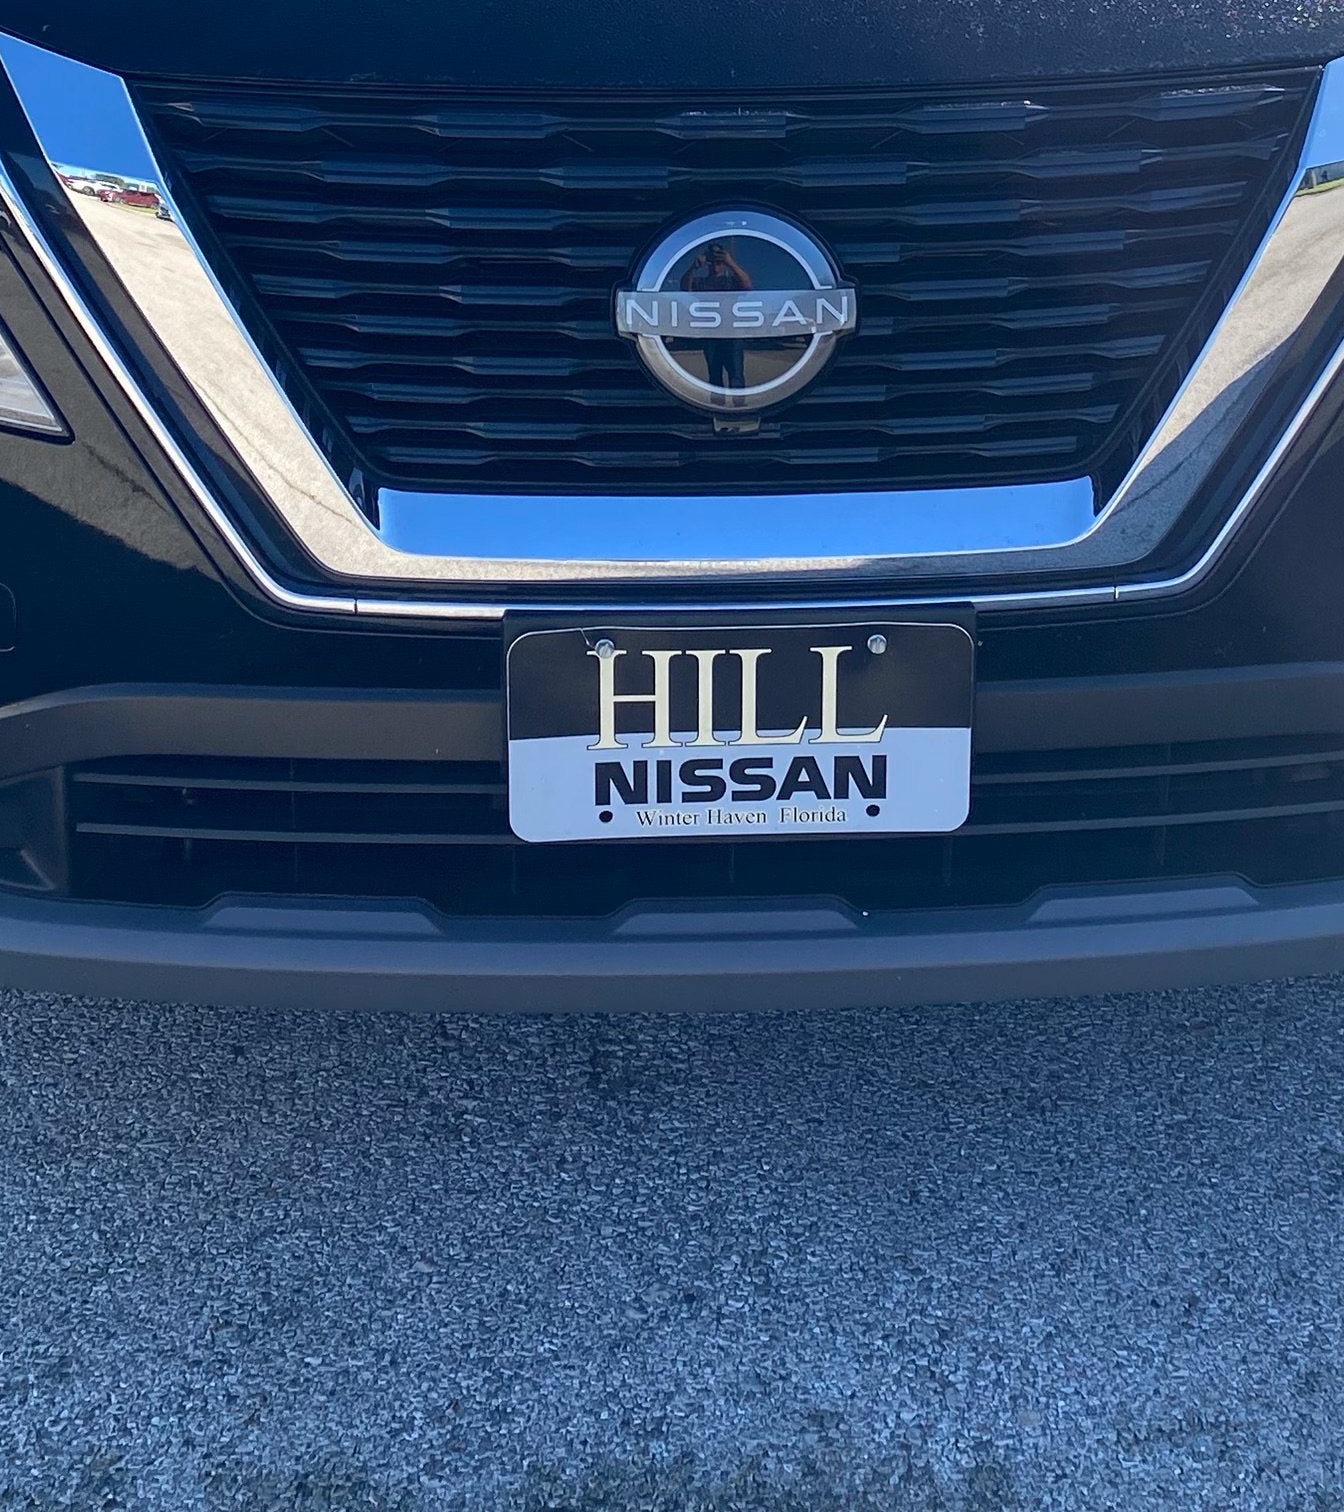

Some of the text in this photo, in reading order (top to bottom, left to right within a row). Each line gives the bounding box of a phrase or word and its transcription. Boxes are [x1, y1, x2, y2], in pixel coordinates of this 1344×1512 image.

[626, 296, 848, 329] NISSAN
[586, 645, 889, 751] HILL
[594, 754, 888, 807] NISSAN
[635, 806, 847, 827] Winter Haven Florida
